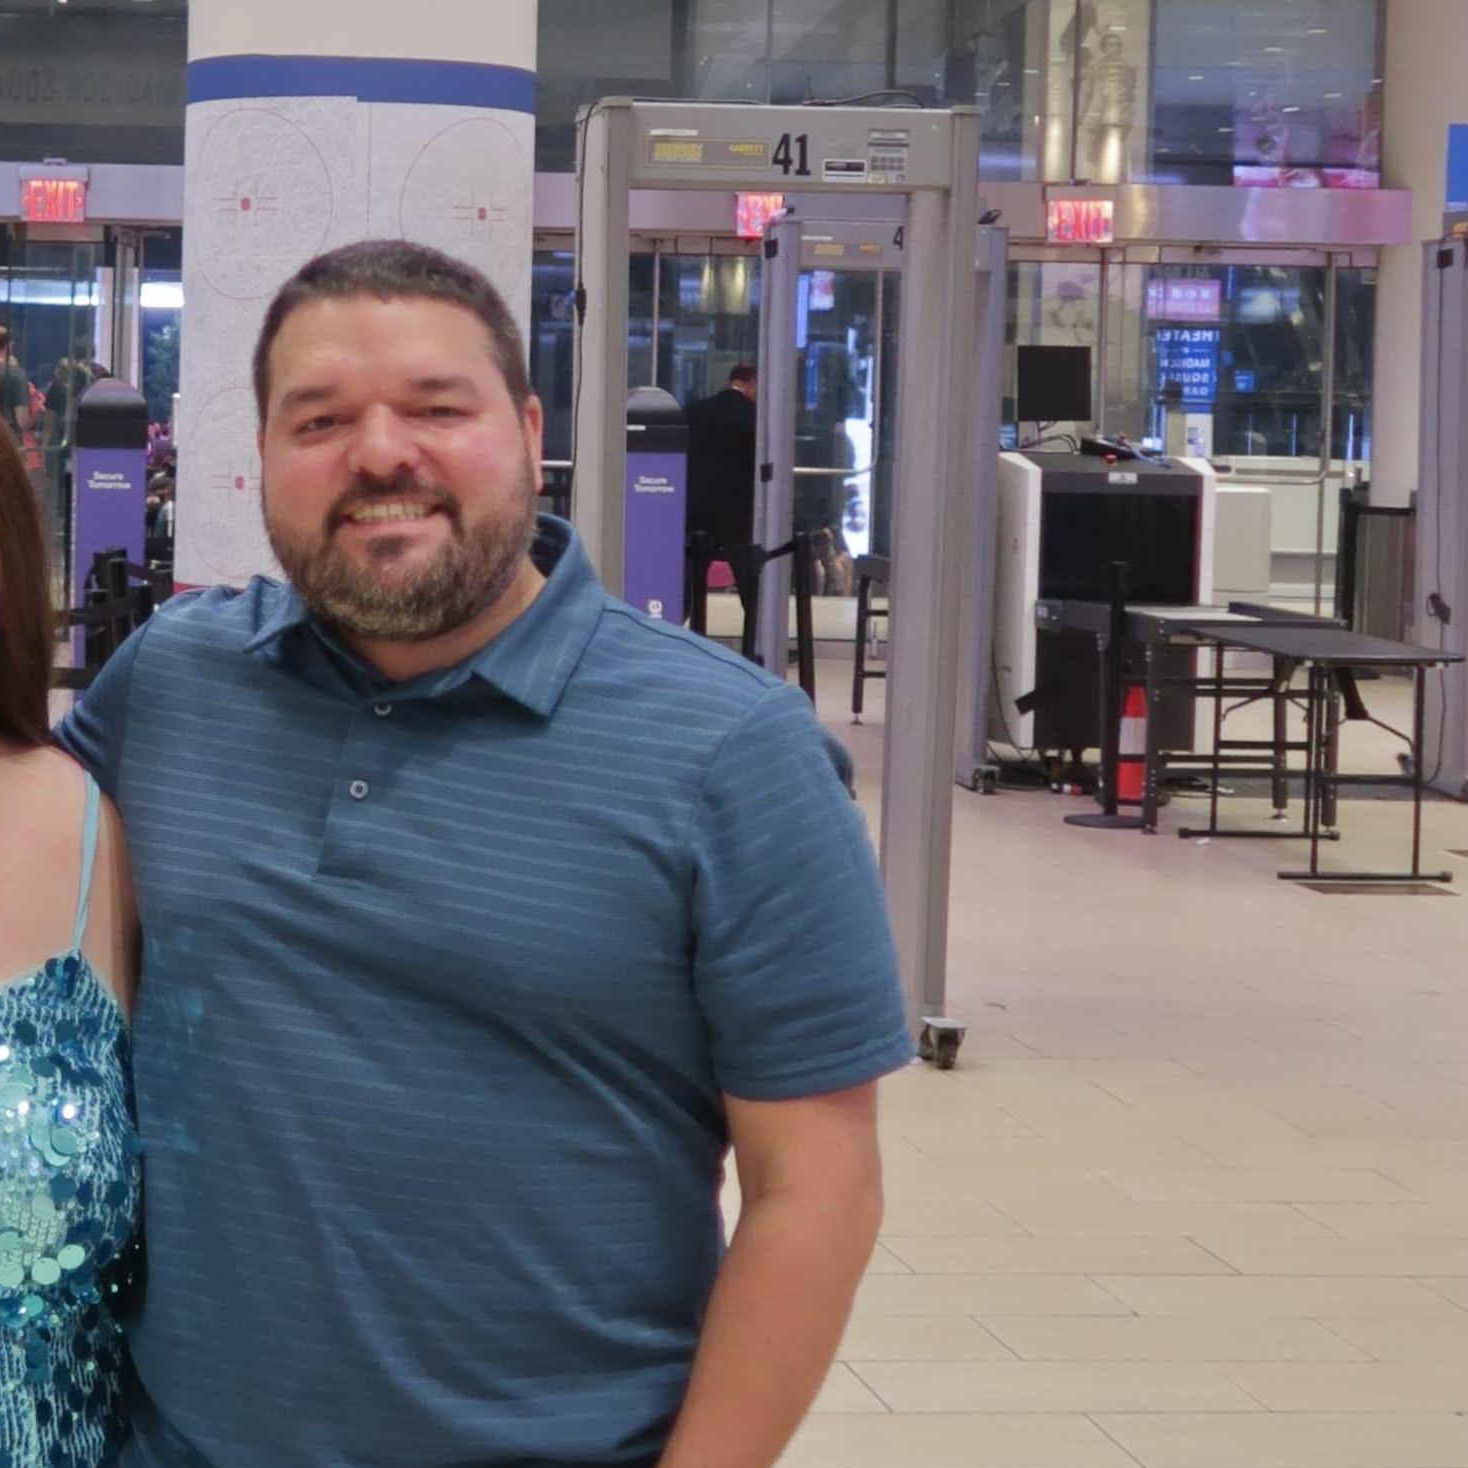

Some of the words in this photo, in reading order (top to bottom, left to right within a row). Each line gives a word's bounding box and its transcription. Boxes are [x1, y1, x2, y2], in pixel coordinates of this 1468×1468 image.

[772, 133, 811, 175] 41
[30, 180, 79, 221] EXIT
[1056, 201, 1105, 241] EXIT
[93, 471, 124, 480] Secure
[87, 480, 132, 489] Tomorrow
[639, 476, 668, 485] Secure
[634, 484, 675, 493] Tomorrow
